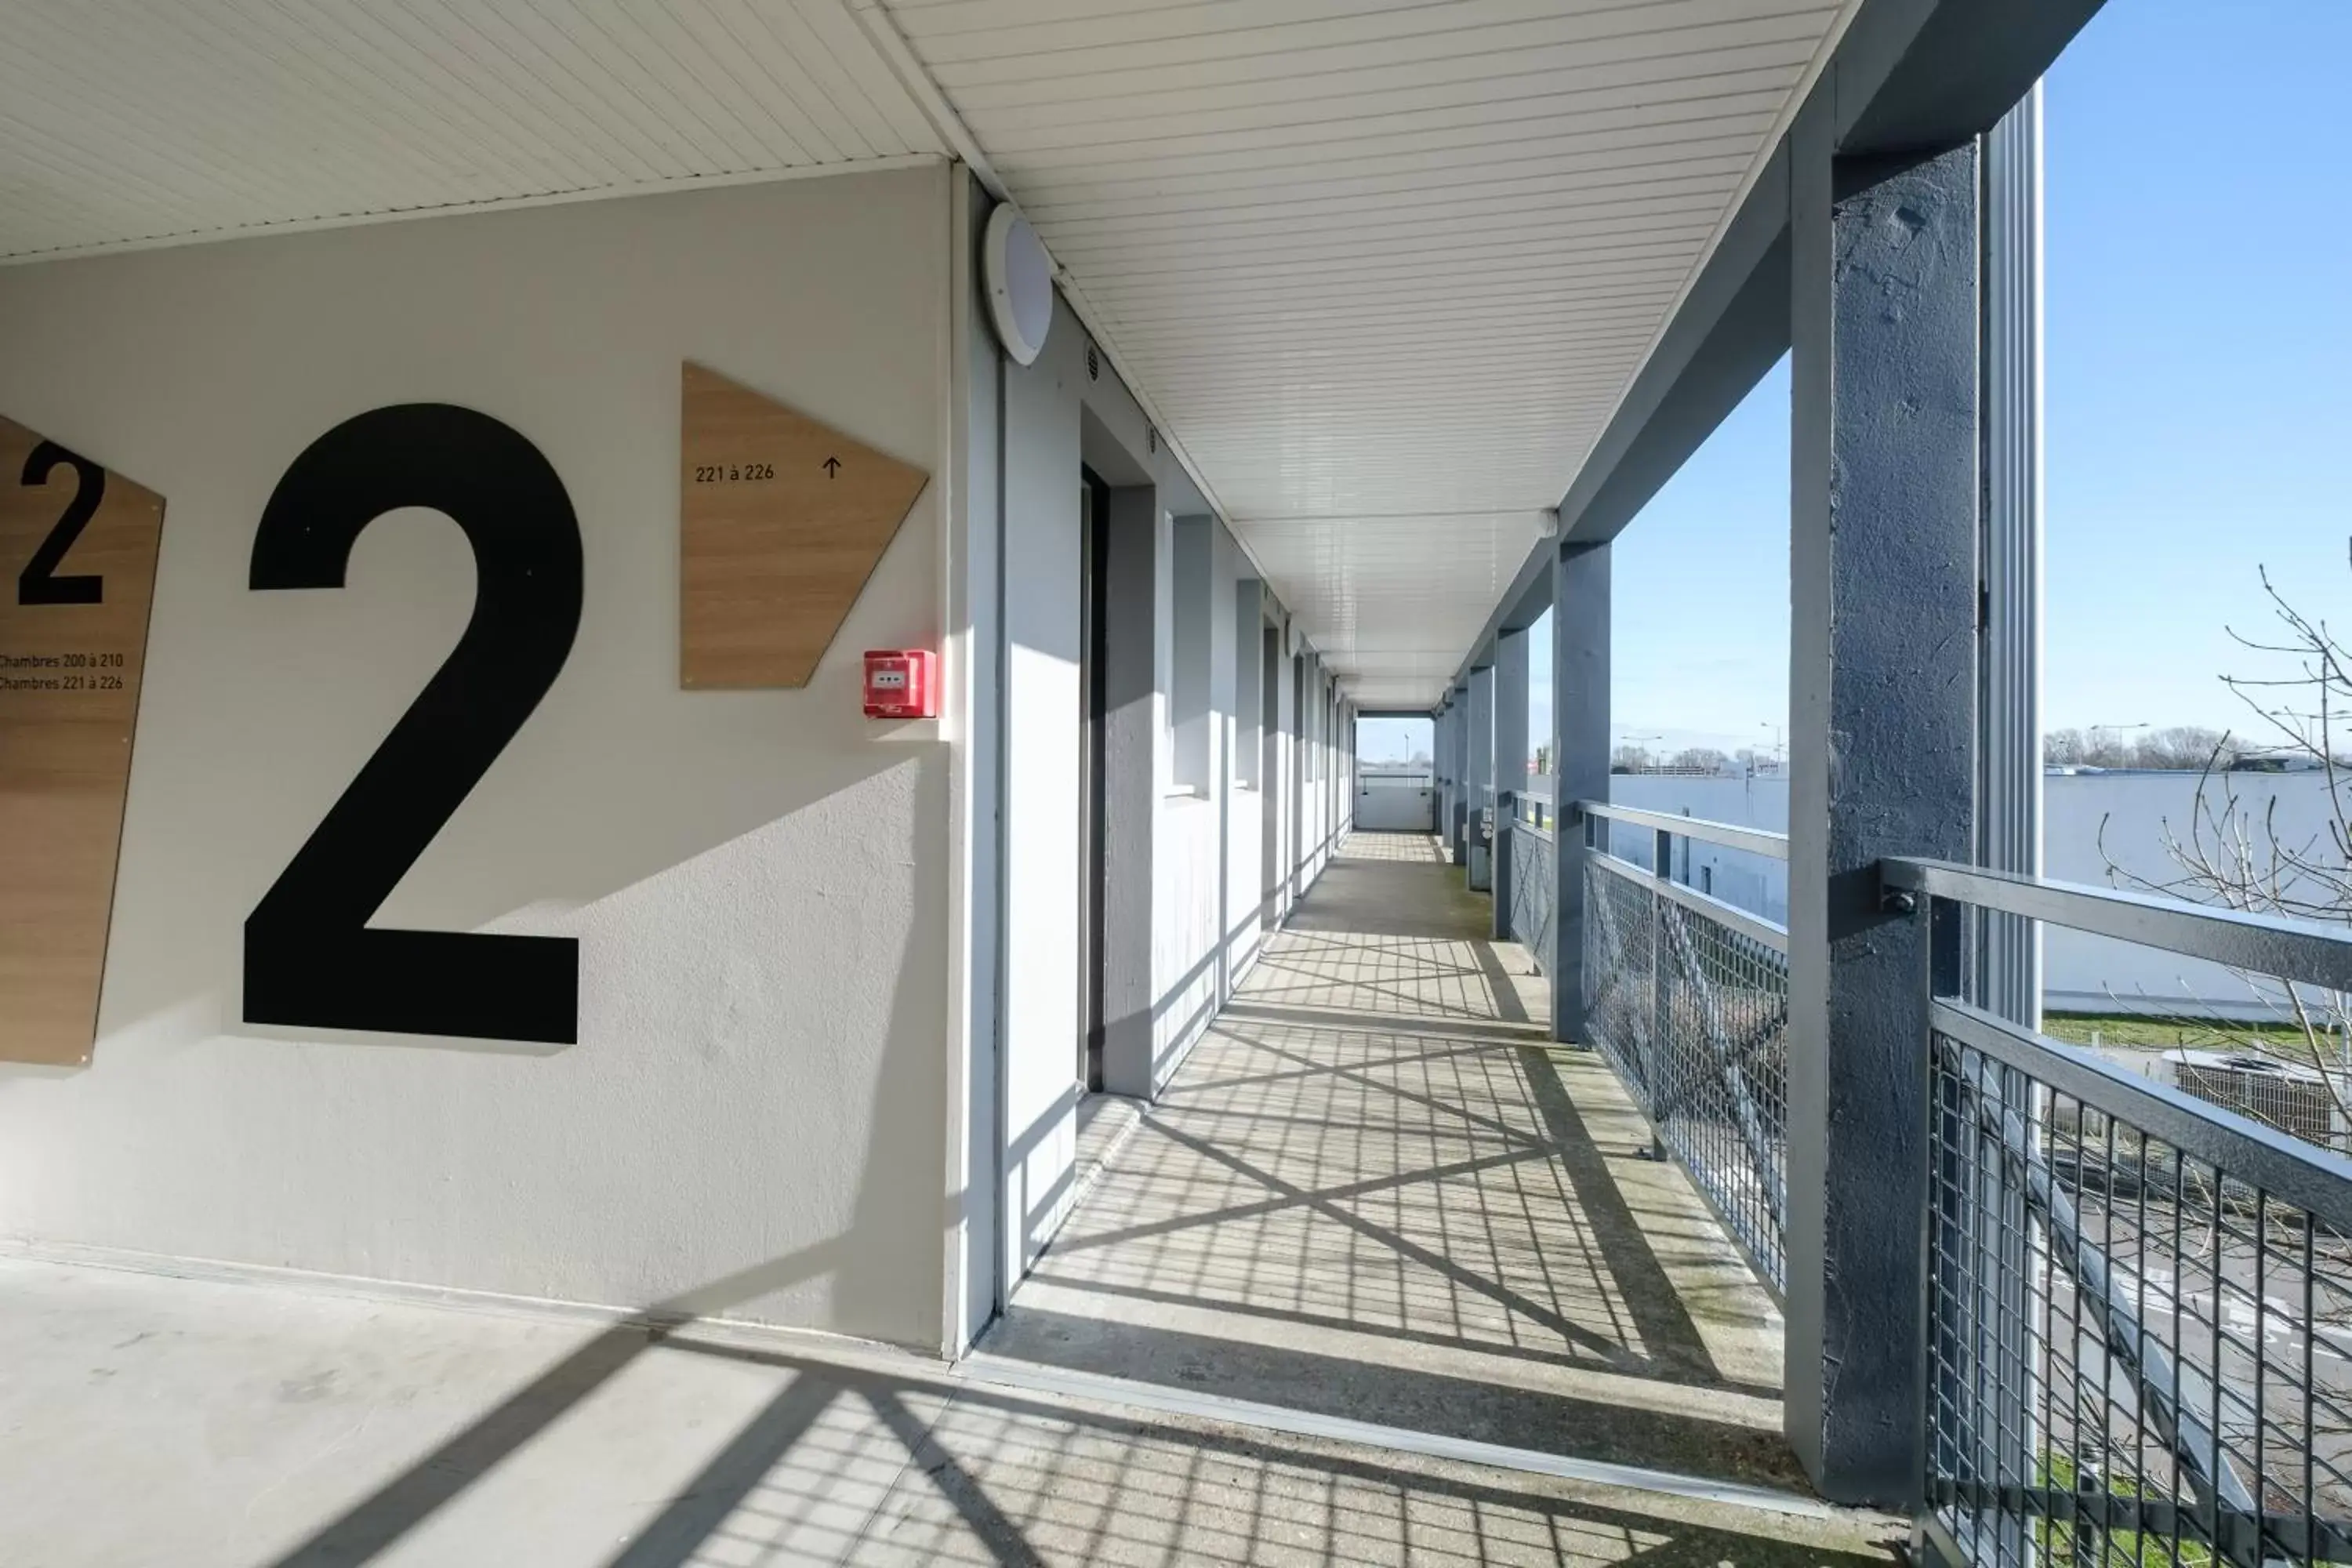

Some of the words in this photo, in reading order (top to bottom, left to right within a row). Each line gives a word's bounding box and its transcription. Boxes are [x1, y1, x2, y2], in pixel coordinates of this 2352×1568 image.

[695, 466, 724, 482] 221
[730, 464, 739, 481] à
[745, 463, 775, 480] 226
[19, 440, 105, 605] 2
[63, 653, 86, 667] 200
[89, 653, 96, 667] à
[100, 653, 123, 666] 210
[63, 676, 85, 690] 221
[89, 675, 96, 689] à
[100, 676, 123, 689] 226
[243, 402, 583, 1045] 2
